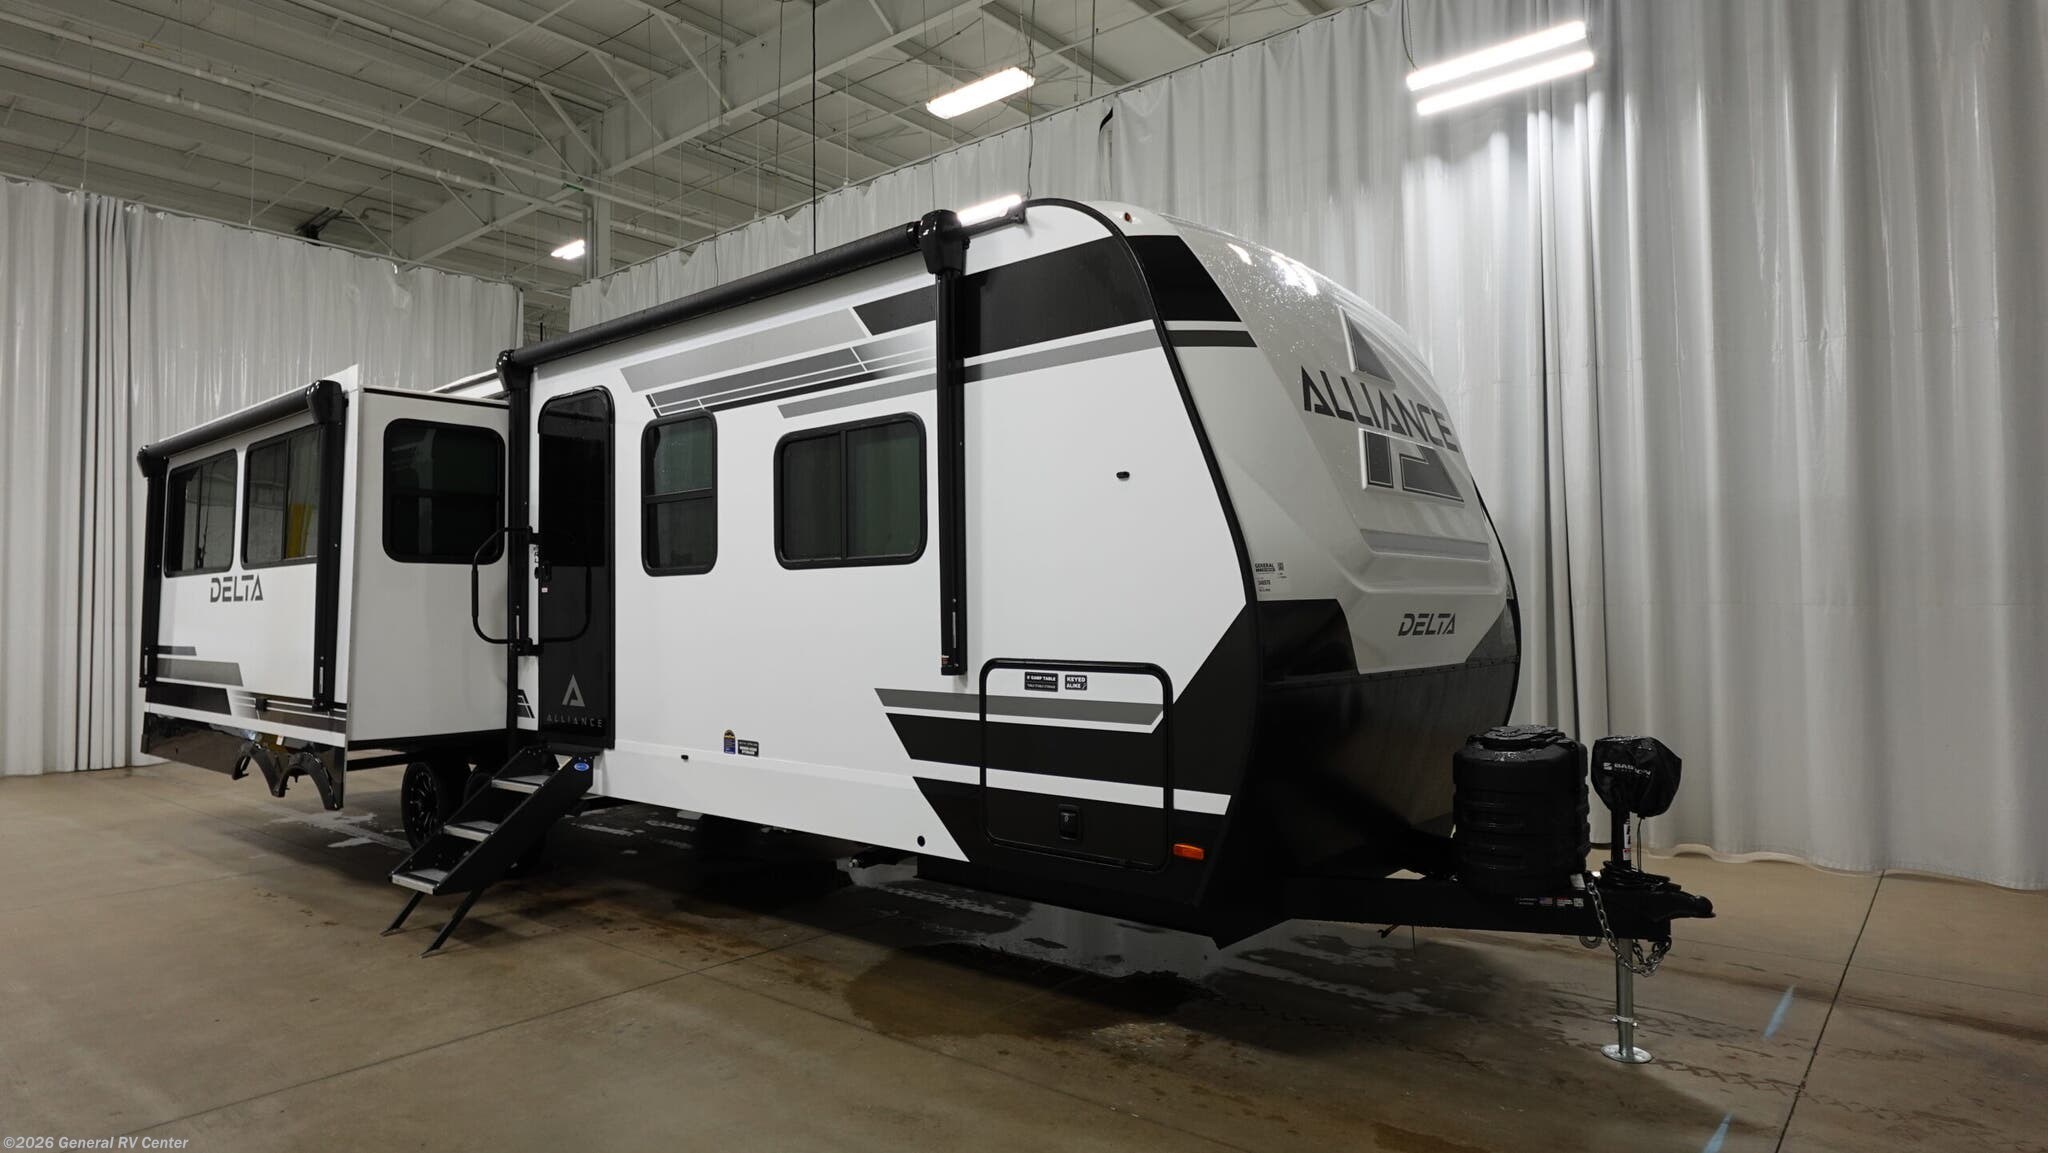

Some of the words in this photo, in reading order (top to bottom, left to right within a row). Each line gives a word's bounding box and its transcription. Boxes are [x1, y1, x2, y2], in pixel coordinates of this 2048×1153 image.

[1301, 366, 1460, 453] ALLIANCE
[209, 574, 264, 603] DELTA
[1397, 613, 1457, 637] DELTA
[546, 713, 603, 728] ALLIANCE
